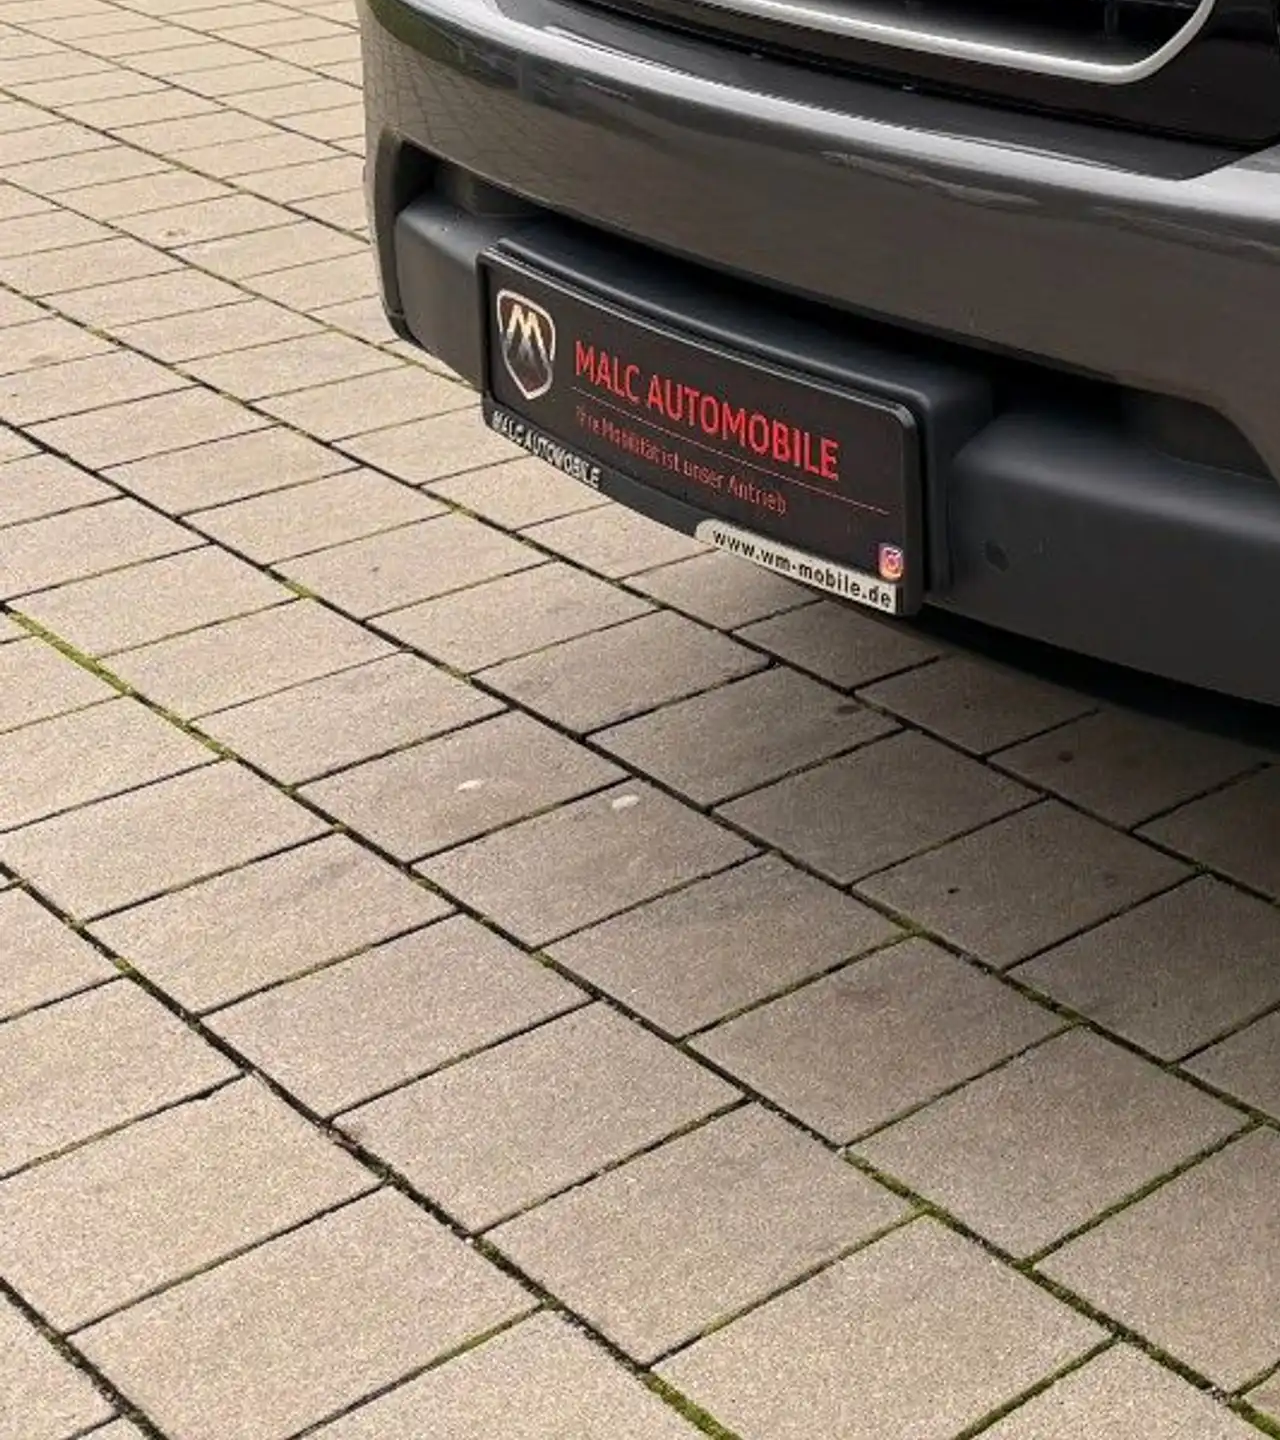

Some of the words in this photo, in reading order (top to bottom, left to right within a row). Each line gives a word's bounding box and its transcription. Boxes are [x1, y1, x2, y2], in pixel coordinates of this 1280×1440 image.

[491, 410, 523, 444] MALC
[523, 428, 601, 488] AUTOMOBILE
[575, 340, 640, 404] MALC
[647, 374, 839, 481] AUTOMOBILE
[683, 459, 724, 490] unser
[728, 475, 788, 516] Antrieb
[712, 529, 893, 609] www.wm-mobile.de
